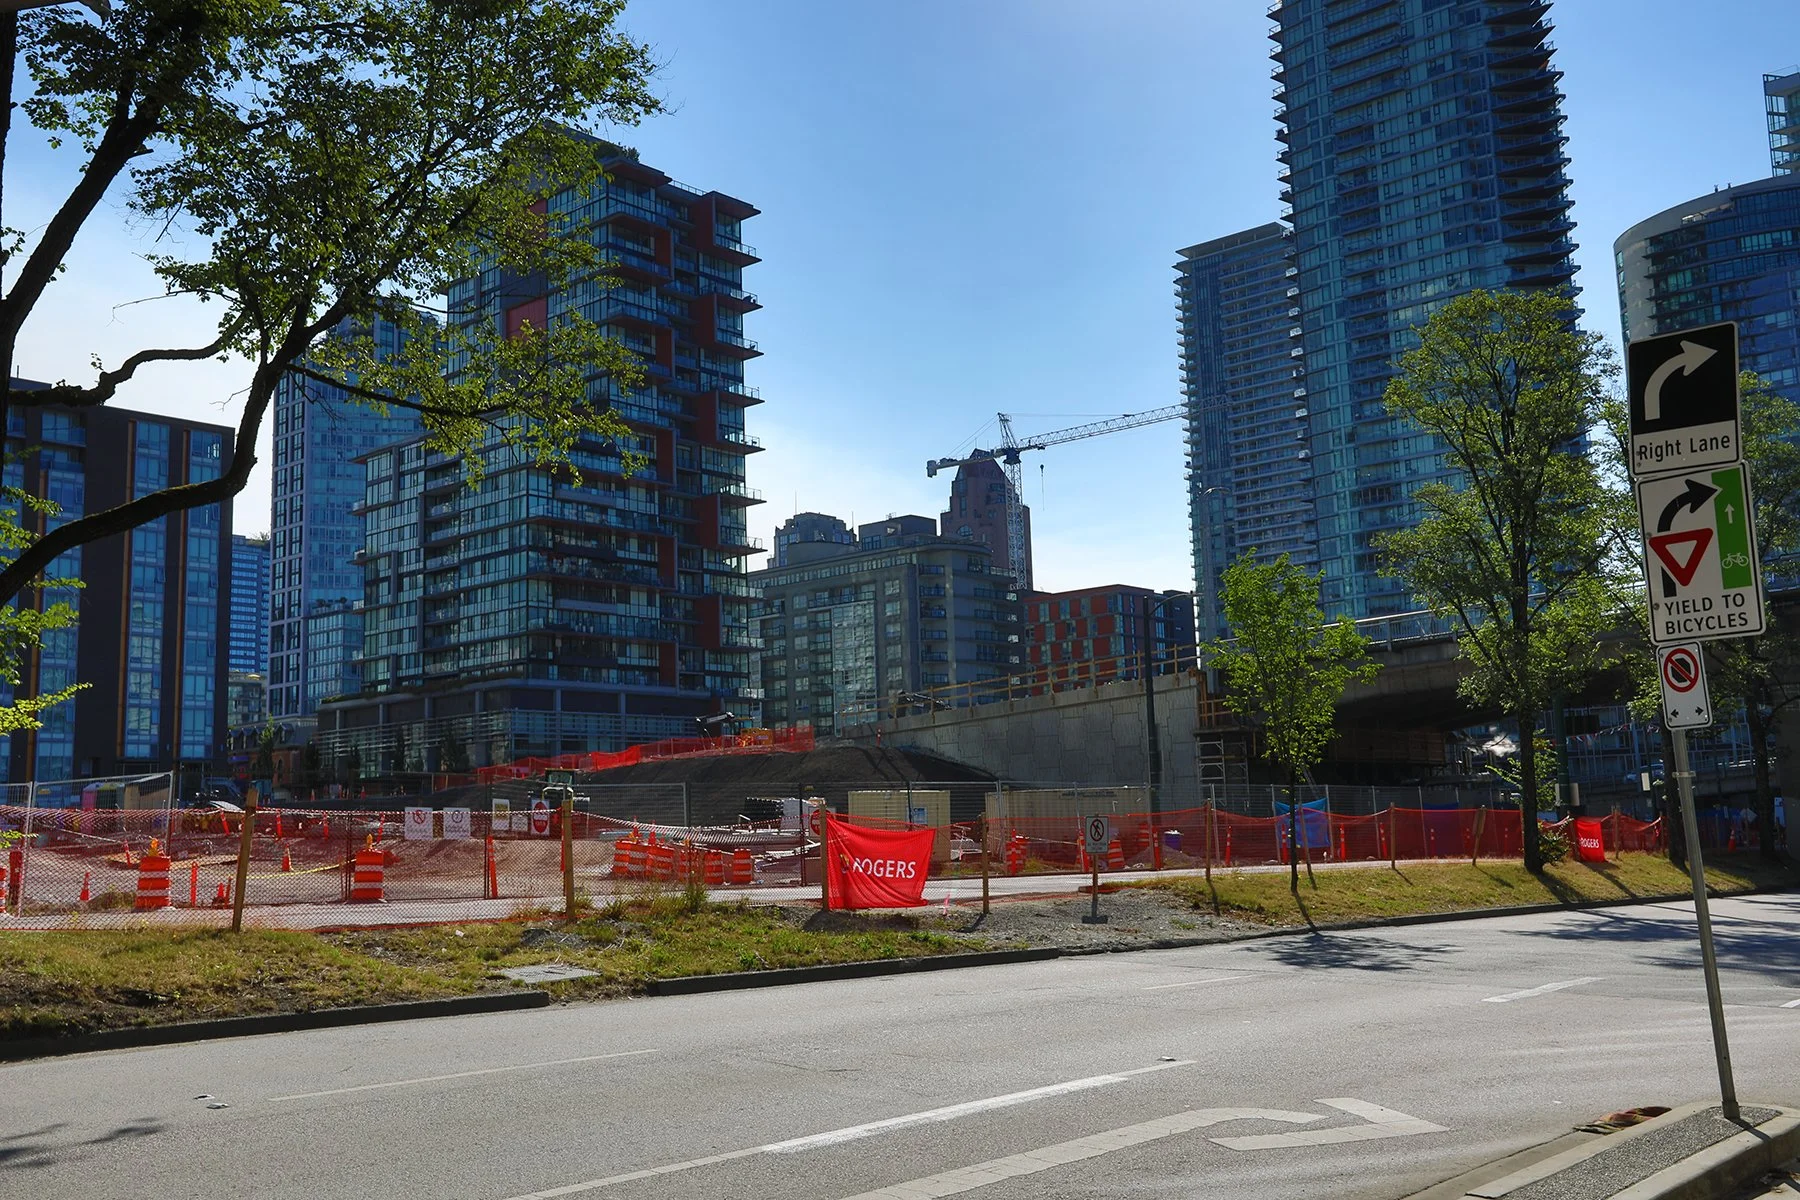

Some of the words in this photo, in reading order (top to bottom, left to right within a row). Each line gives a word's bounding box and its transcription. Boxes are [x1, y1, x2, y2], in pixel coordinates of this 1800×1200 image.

[1638, 440, 1682, 462] Right
[1690, 435, 1730, 453] Lane
[1665, 597, 1713, 616] YIELD
[1722, 593, 1745, 609] TO
[1666, 612, 1748, 635] BICYCLES
[1579, 837, 1600, 848] ROGERS
[852, 857, 916, 879] ROGERS
